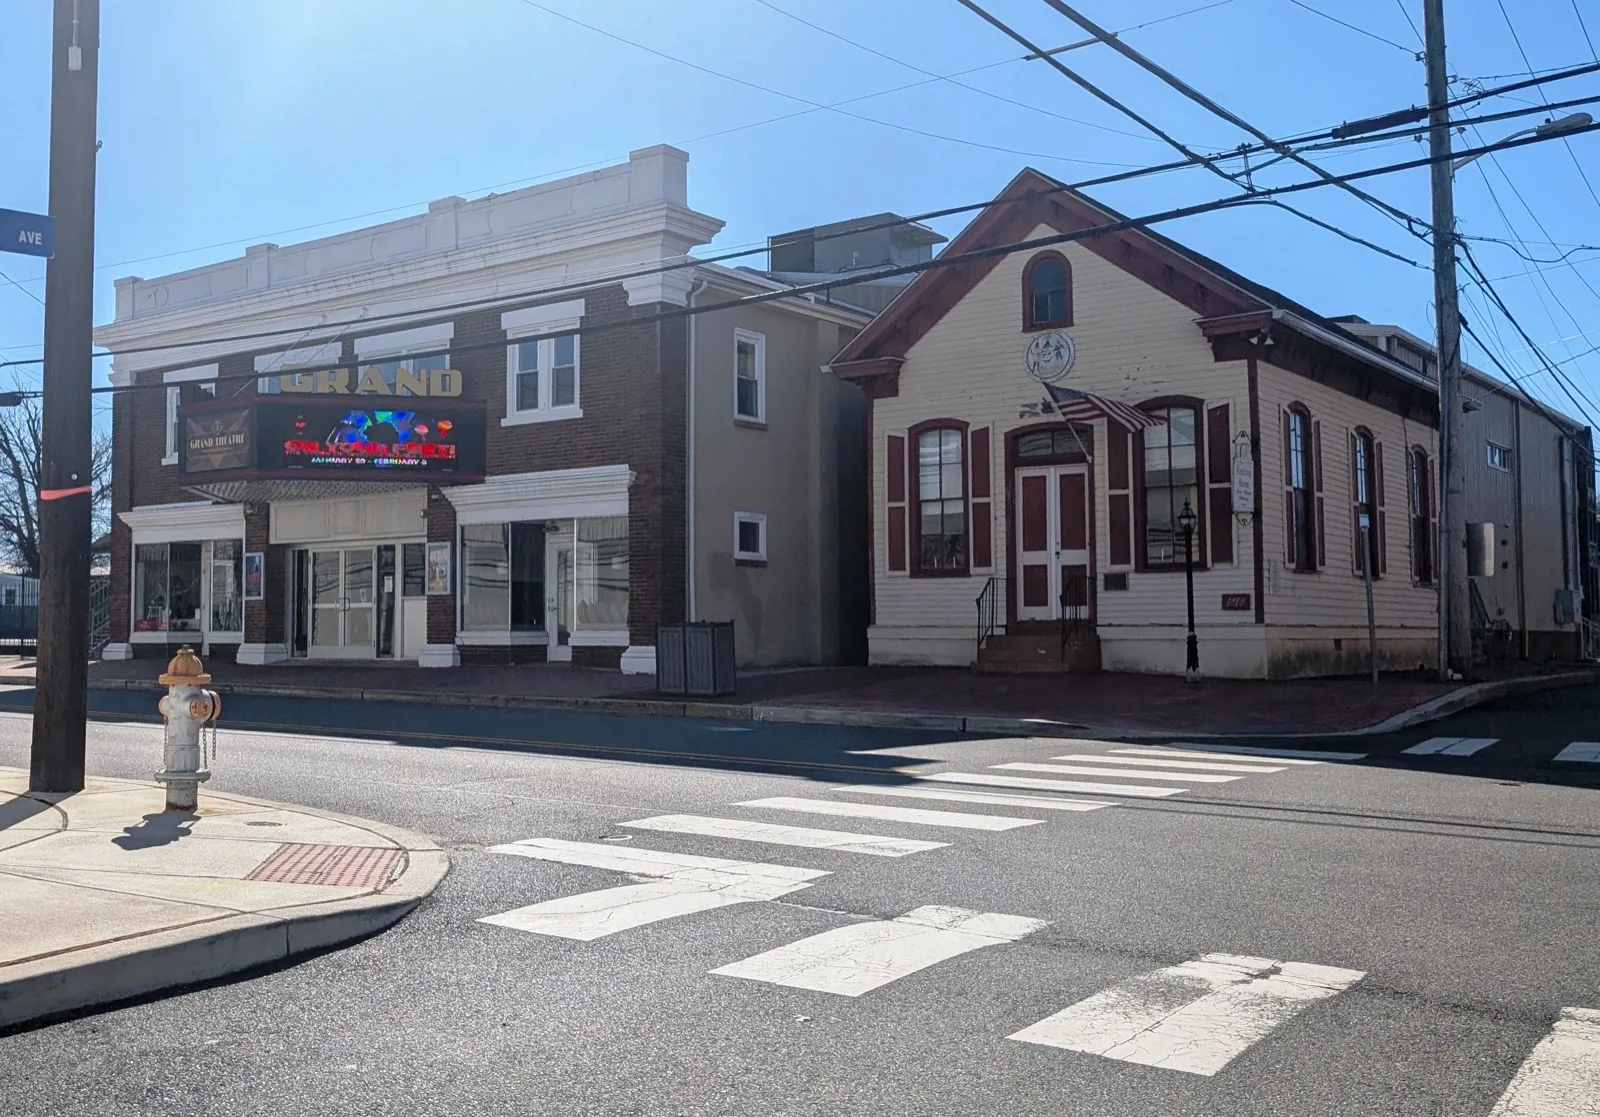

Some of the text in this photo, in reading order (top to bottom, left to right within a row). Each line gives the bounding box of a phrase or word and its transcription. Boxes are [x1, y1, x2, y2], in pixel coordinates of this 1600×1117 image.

[19, 230, 42, 245] AVE
[280, 363, 462, 397] GRAND
[190, 434, 244, 449] GRAND THEATRE
